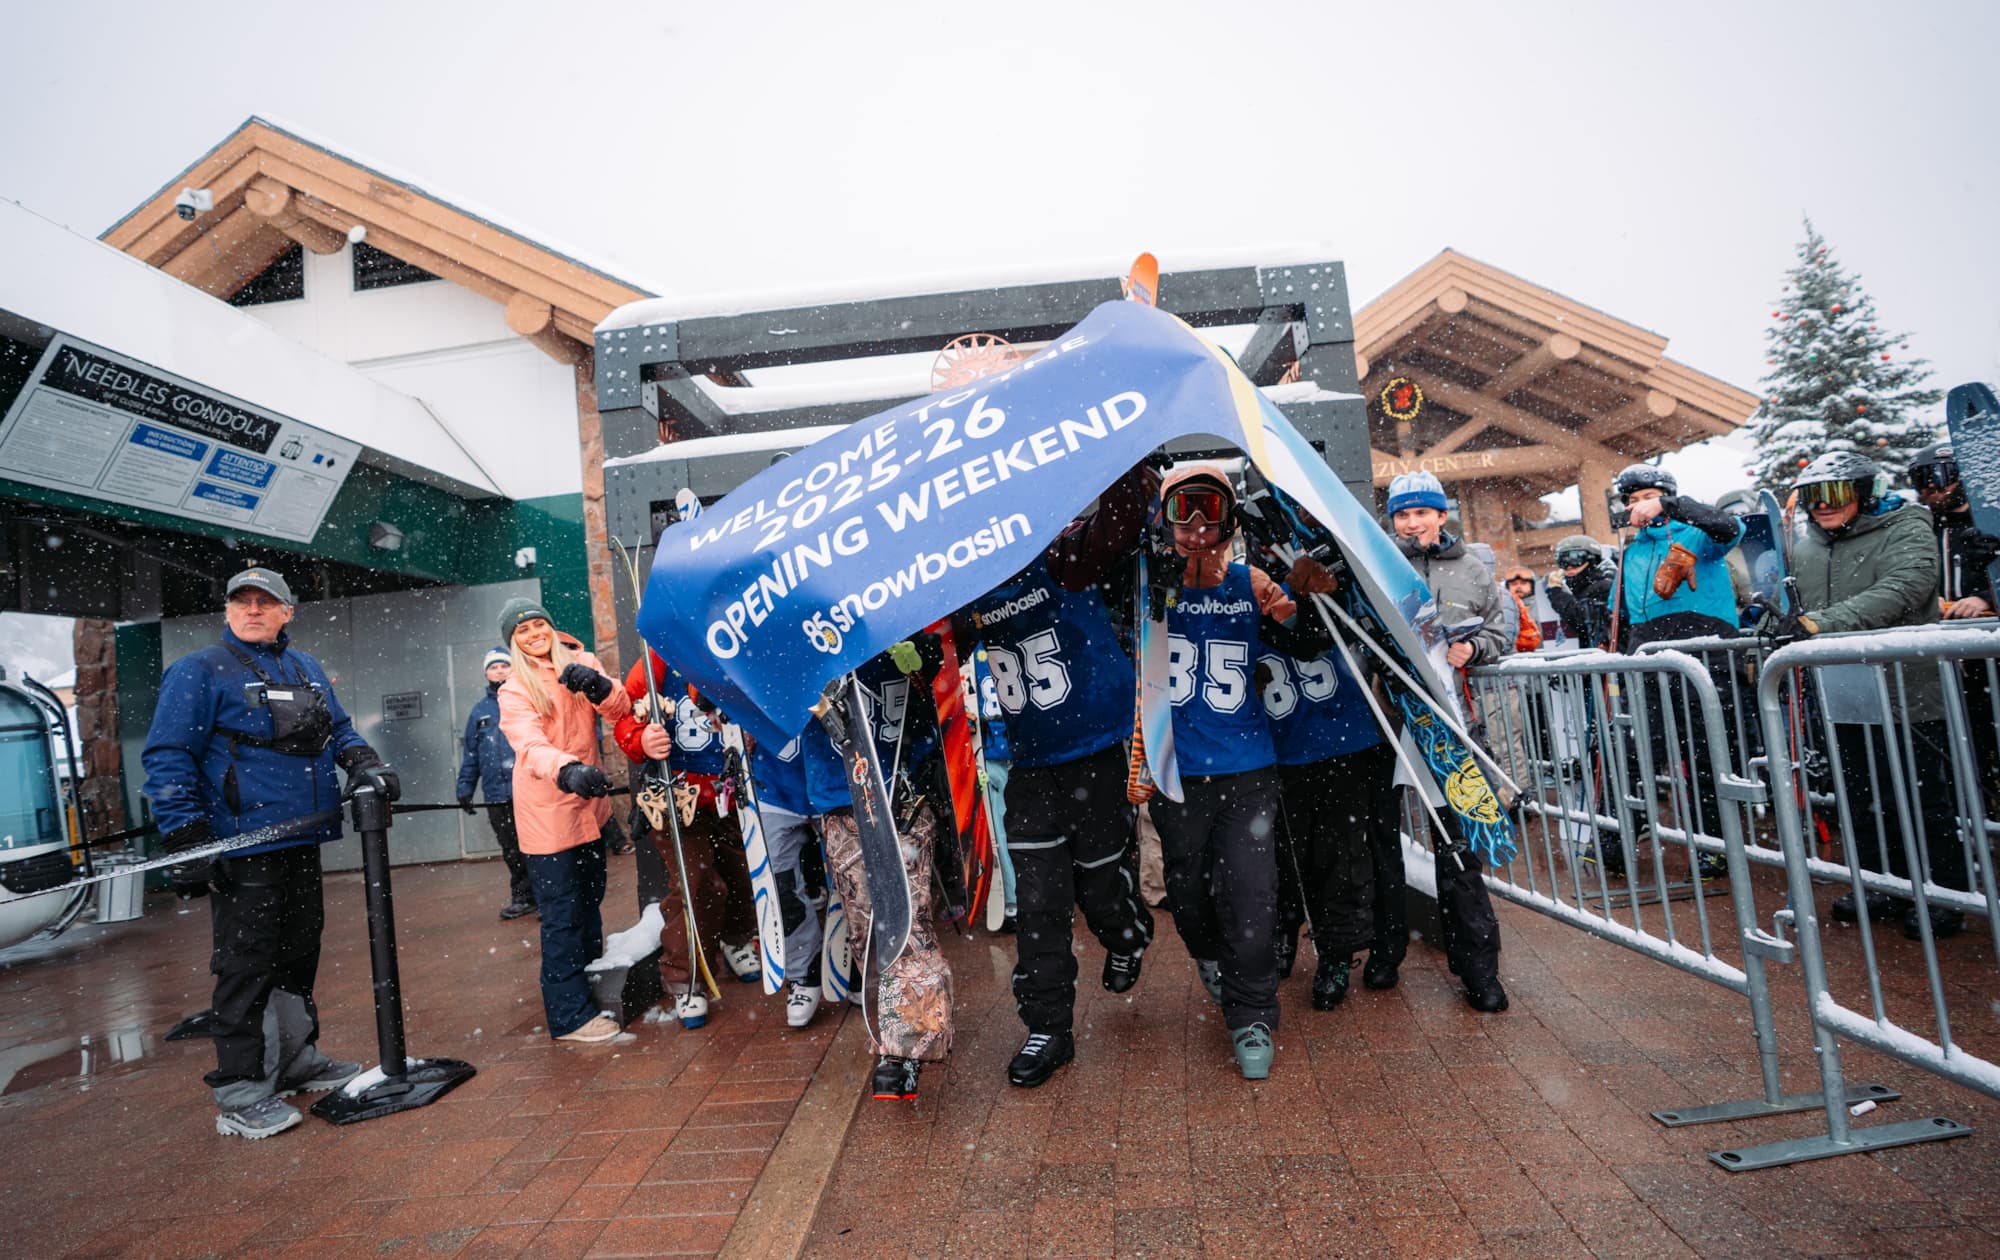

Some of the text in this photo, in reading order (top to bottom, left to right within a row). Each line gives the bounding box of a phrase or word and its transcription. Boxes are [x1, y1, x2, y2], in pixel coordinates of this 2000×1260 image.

[65, 354, 268, 440] NEEDLES GONDOLA
[221, 453, 270, 472] ATTENTION
[689, 419, 898, 552] WELCOME
[908, 387, 975, 421] TO
[752, 395, 1007, 552] 2025-26
[1372, 454, 1495, 477] ZLY CENTER
[706, 390, 1148, 660] OPENING WEEKEND
[828, 512, 1033, 634] snowbasin
[981, 587, 1050, 625] snowbasin
[1176, 599, 1253, 615] snowbasin
[986, 627, 1072, 714] 85
[1168, 633, 1248, 714] 85
[1256, 653, 1338, 720] 85
